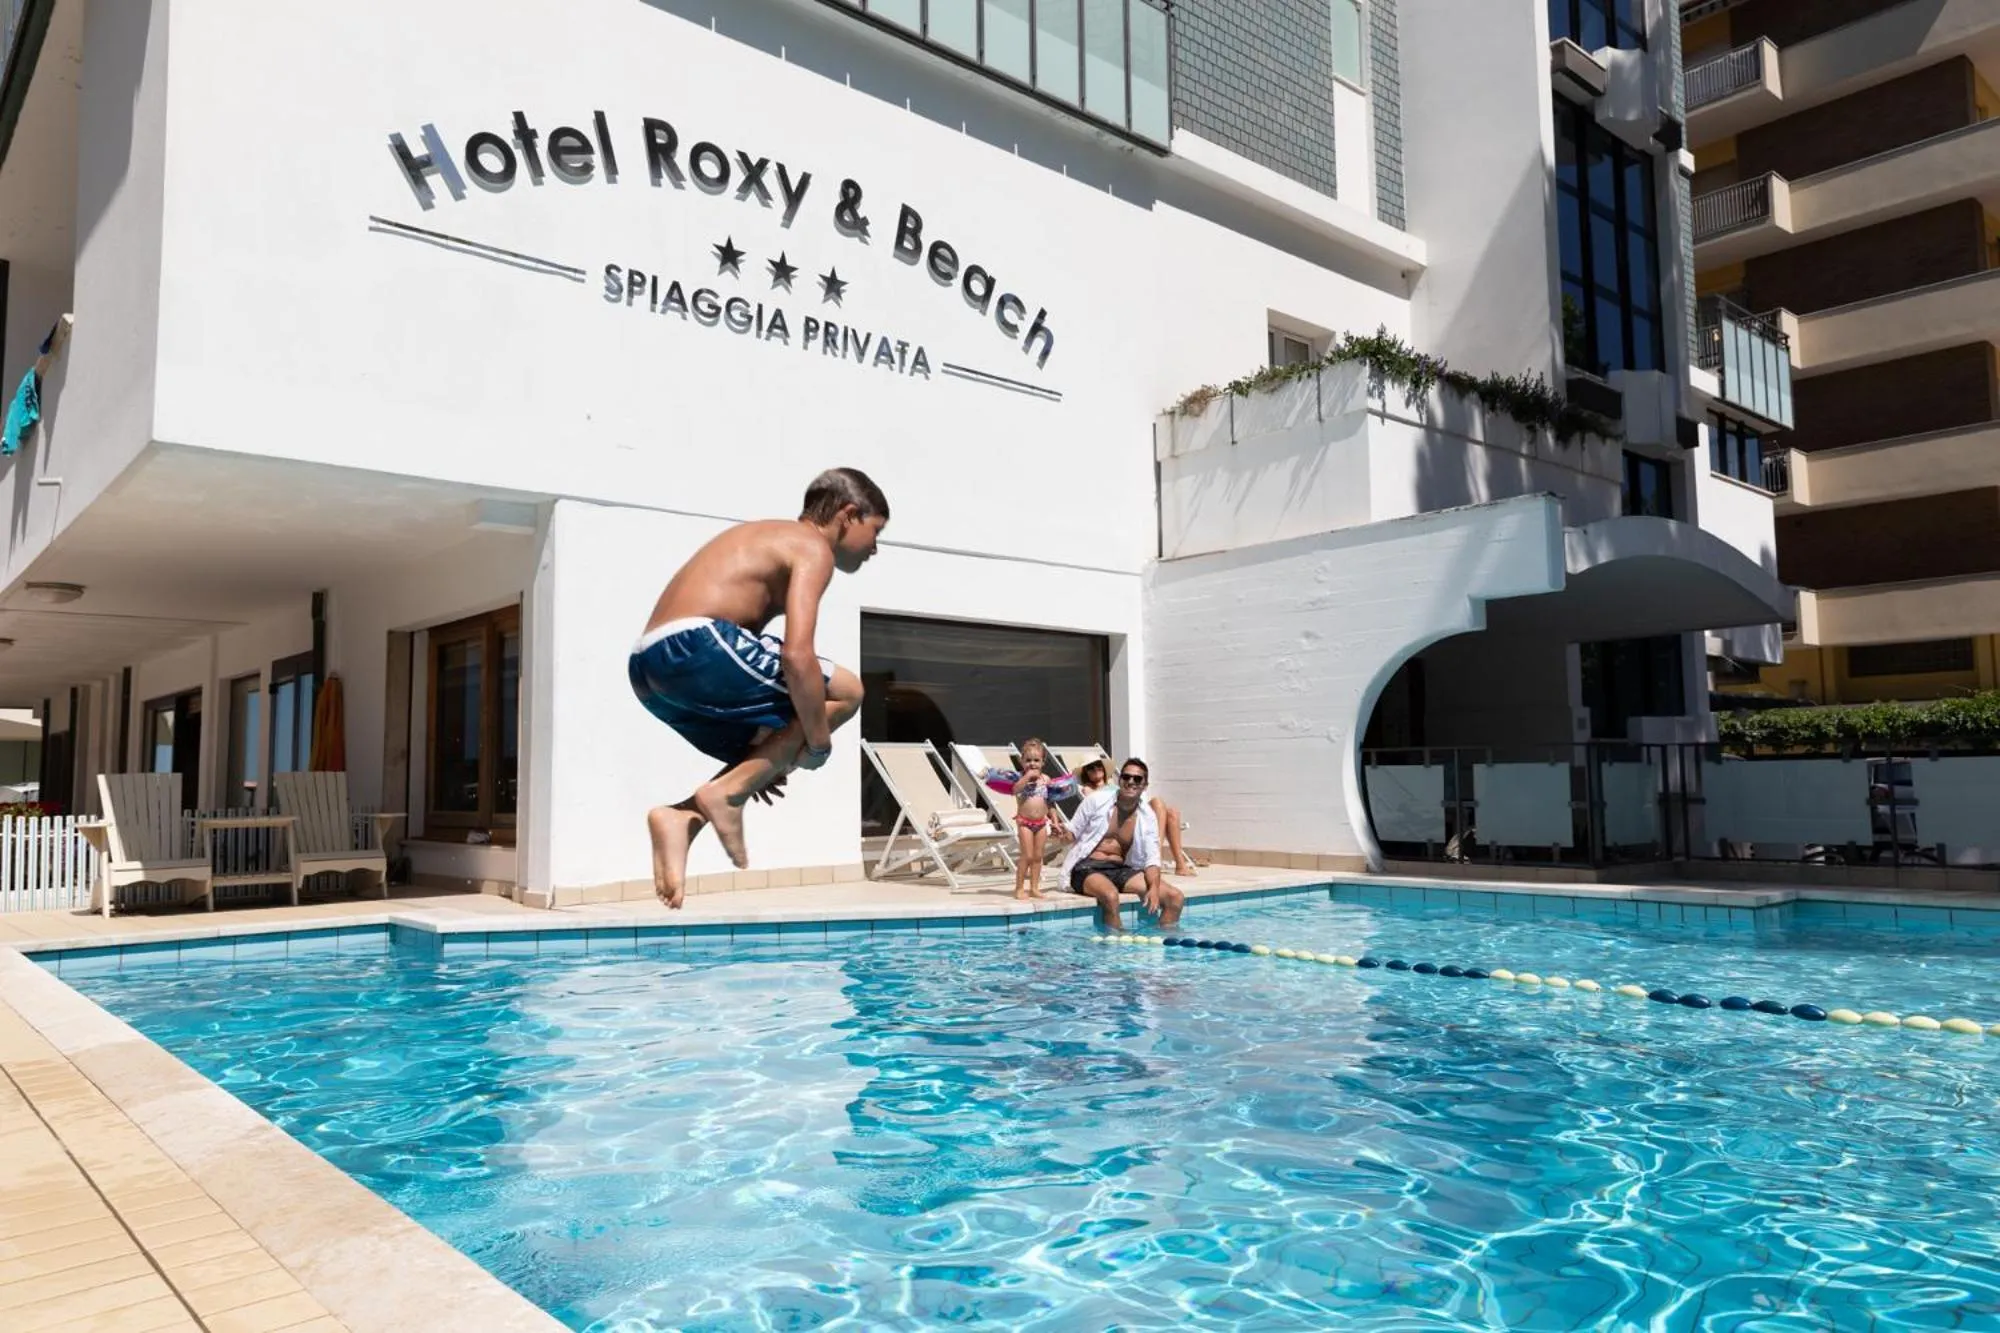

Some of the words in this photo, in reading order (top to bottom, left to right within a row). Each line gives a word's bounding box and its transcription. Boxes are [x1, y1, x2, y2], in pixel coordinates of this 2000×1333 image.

[388, 110, 619, 207] Hotel
[643, 117, 812, 226] Roxy
[833, 178, 871, 242] &
[894, 203, 1054, 367] Beach
[603, 264, 790, 344] SPIAGGIA
[803, 316, 931, 378] PRIVATA
